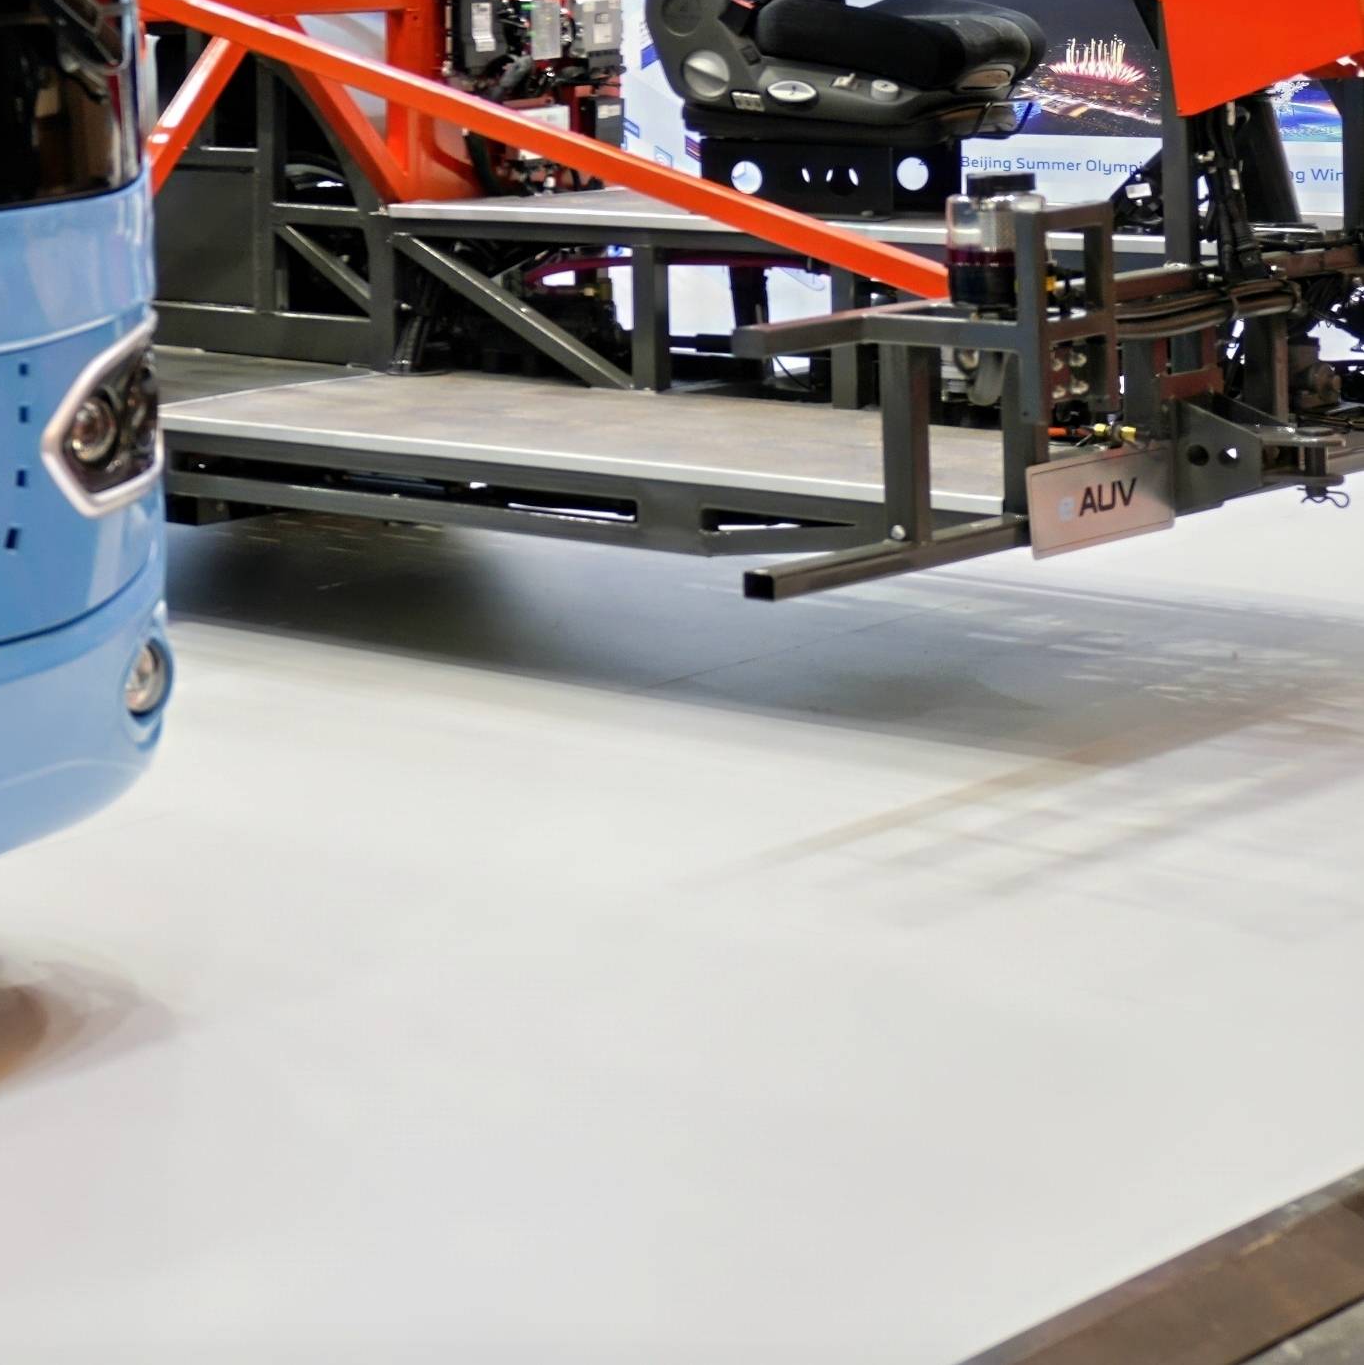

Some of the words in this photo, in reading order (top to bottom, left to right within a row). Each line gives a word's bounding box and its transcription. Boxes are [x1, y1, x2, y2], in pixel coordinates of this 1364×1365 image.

[961, 155, 1012, 172] Beijing
[1016, 158, 1082, 171] Summer
[1079, 478, 1138, 518] AUV
